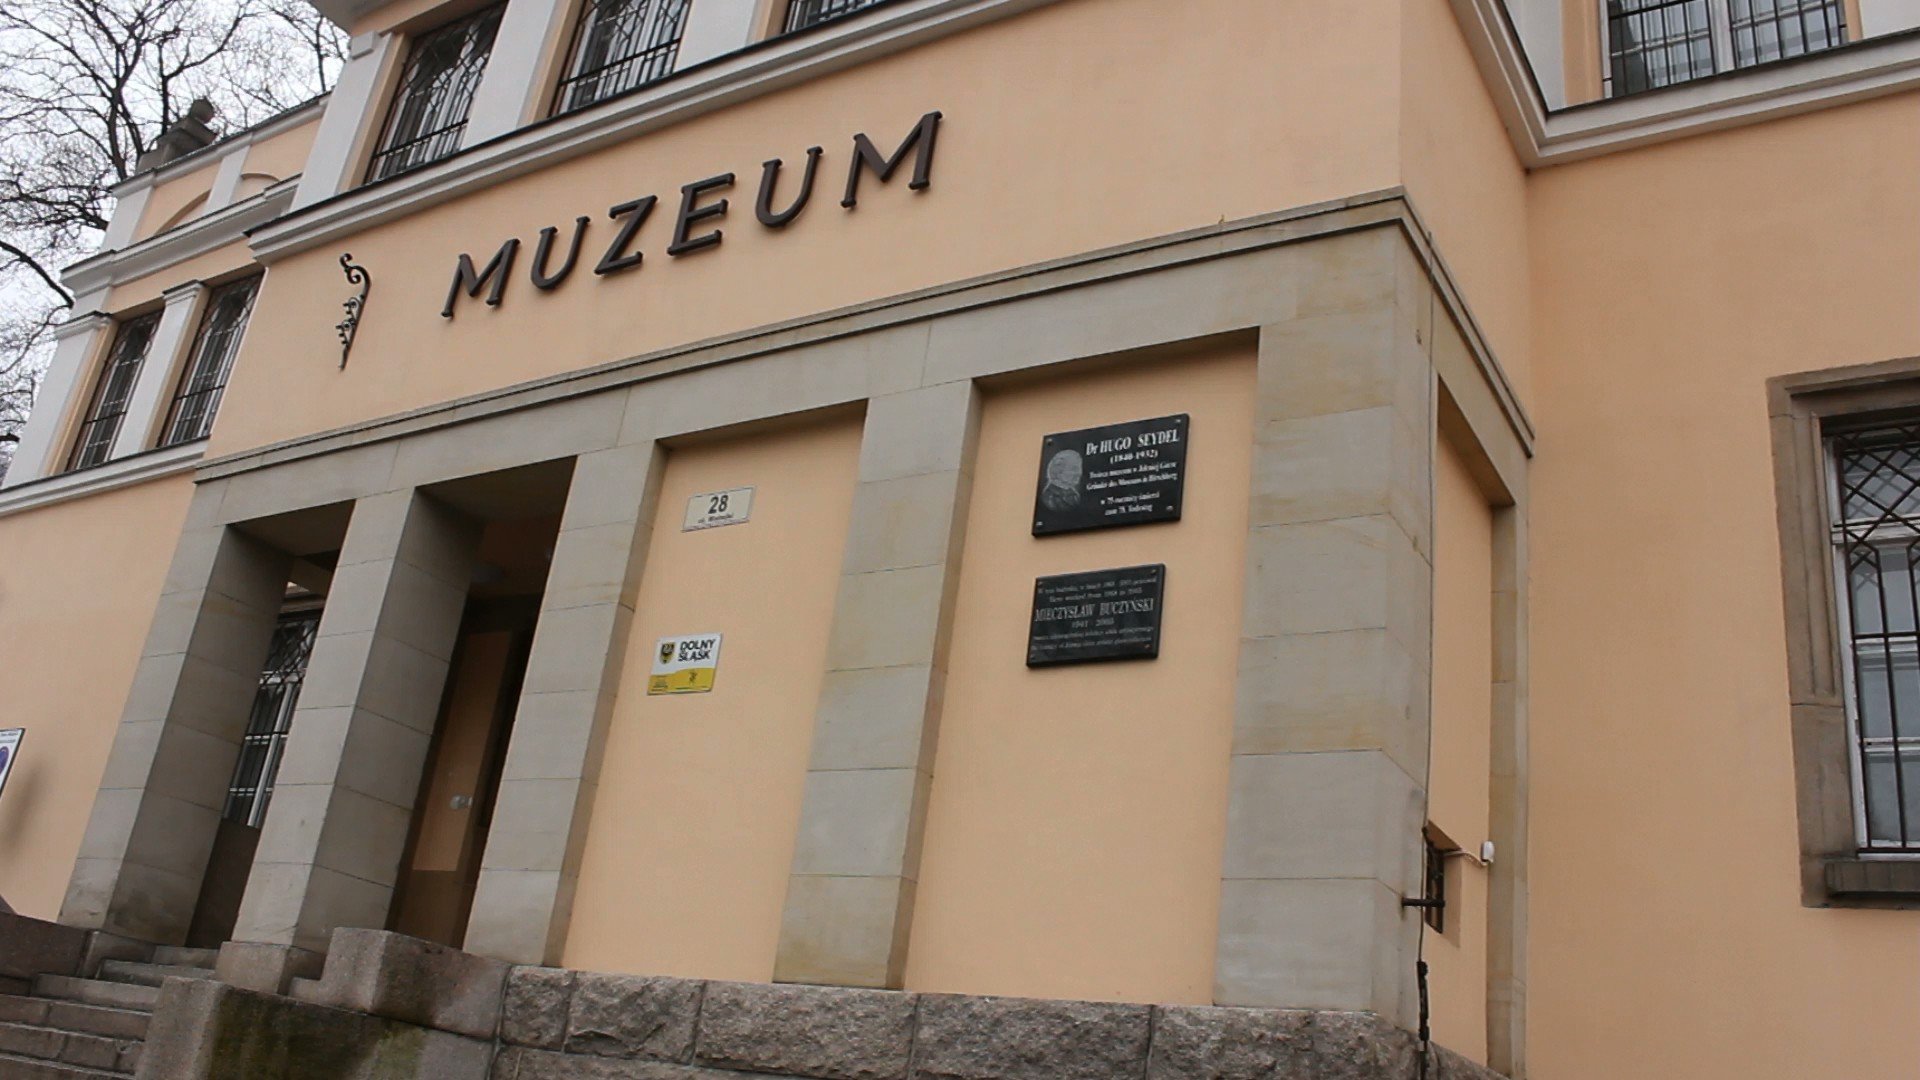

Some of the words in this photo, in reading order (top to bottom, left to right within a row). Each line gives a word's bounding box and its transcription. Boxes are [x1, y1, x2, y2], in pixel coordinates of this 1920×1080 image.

[441, 111, 943, 318] MUZEUM
[1086, 442, 1098, 456] Dr
[1100, 436, 1132, 454] HUGO
[1137, 428, 1180, 448] SEYDEL
[708, 494, 729, 514] 28
[680, 639, 716, 651] DOLNY
